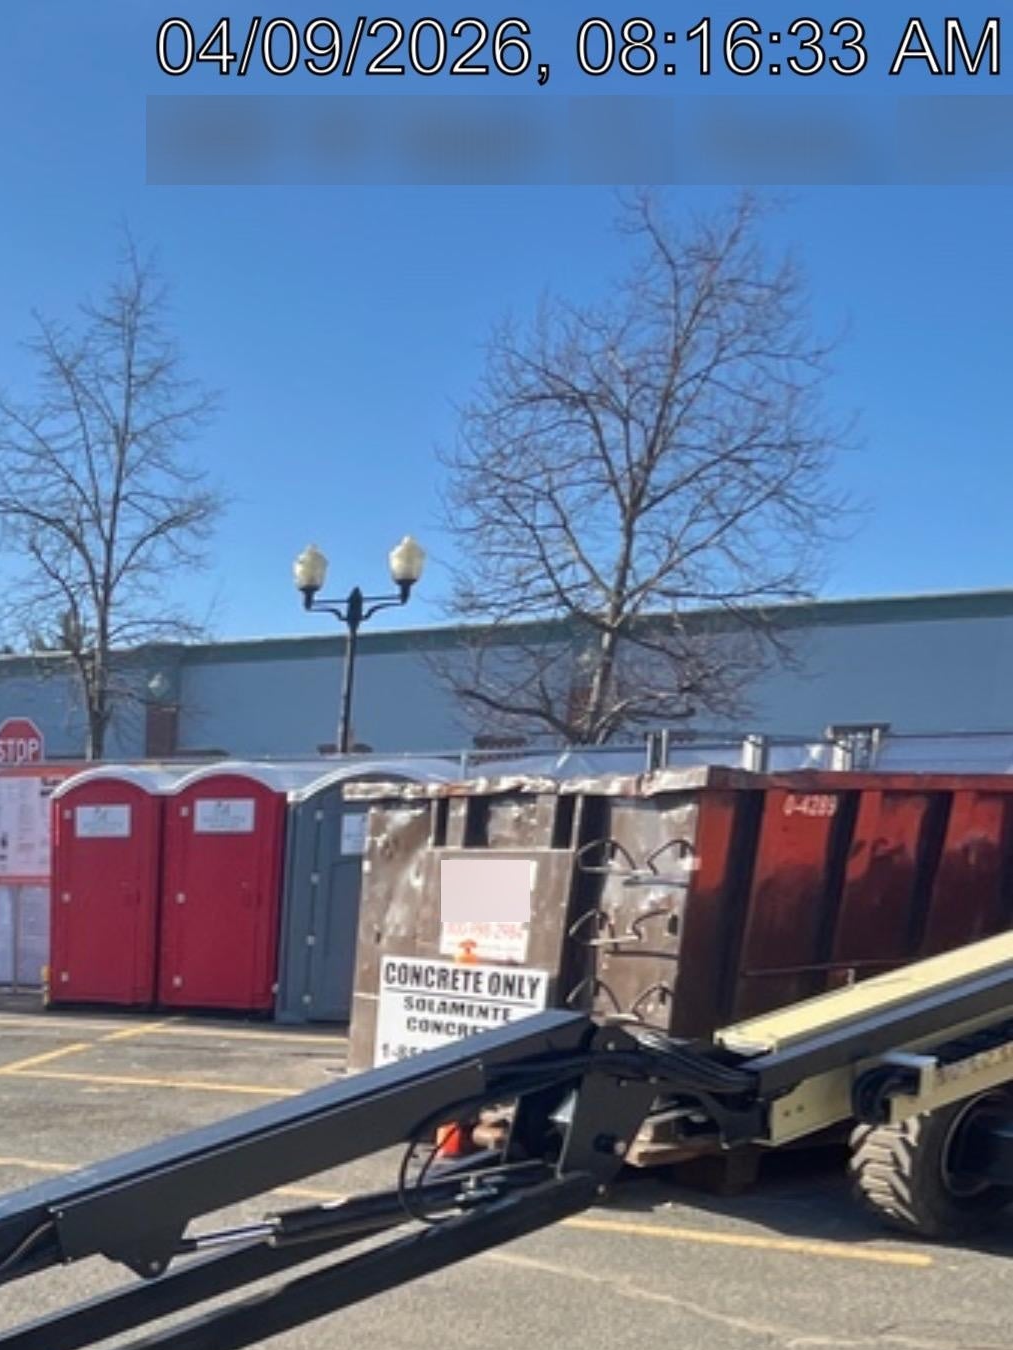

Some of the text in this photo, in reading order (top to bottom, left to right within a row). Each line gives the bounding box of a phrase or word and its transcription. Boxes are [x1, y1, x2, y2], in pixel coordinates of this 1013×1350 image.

[384, 961, 540, 1000] CONCRETE ONLY
[404, 995, 512, 1022] SOLAMENTE
